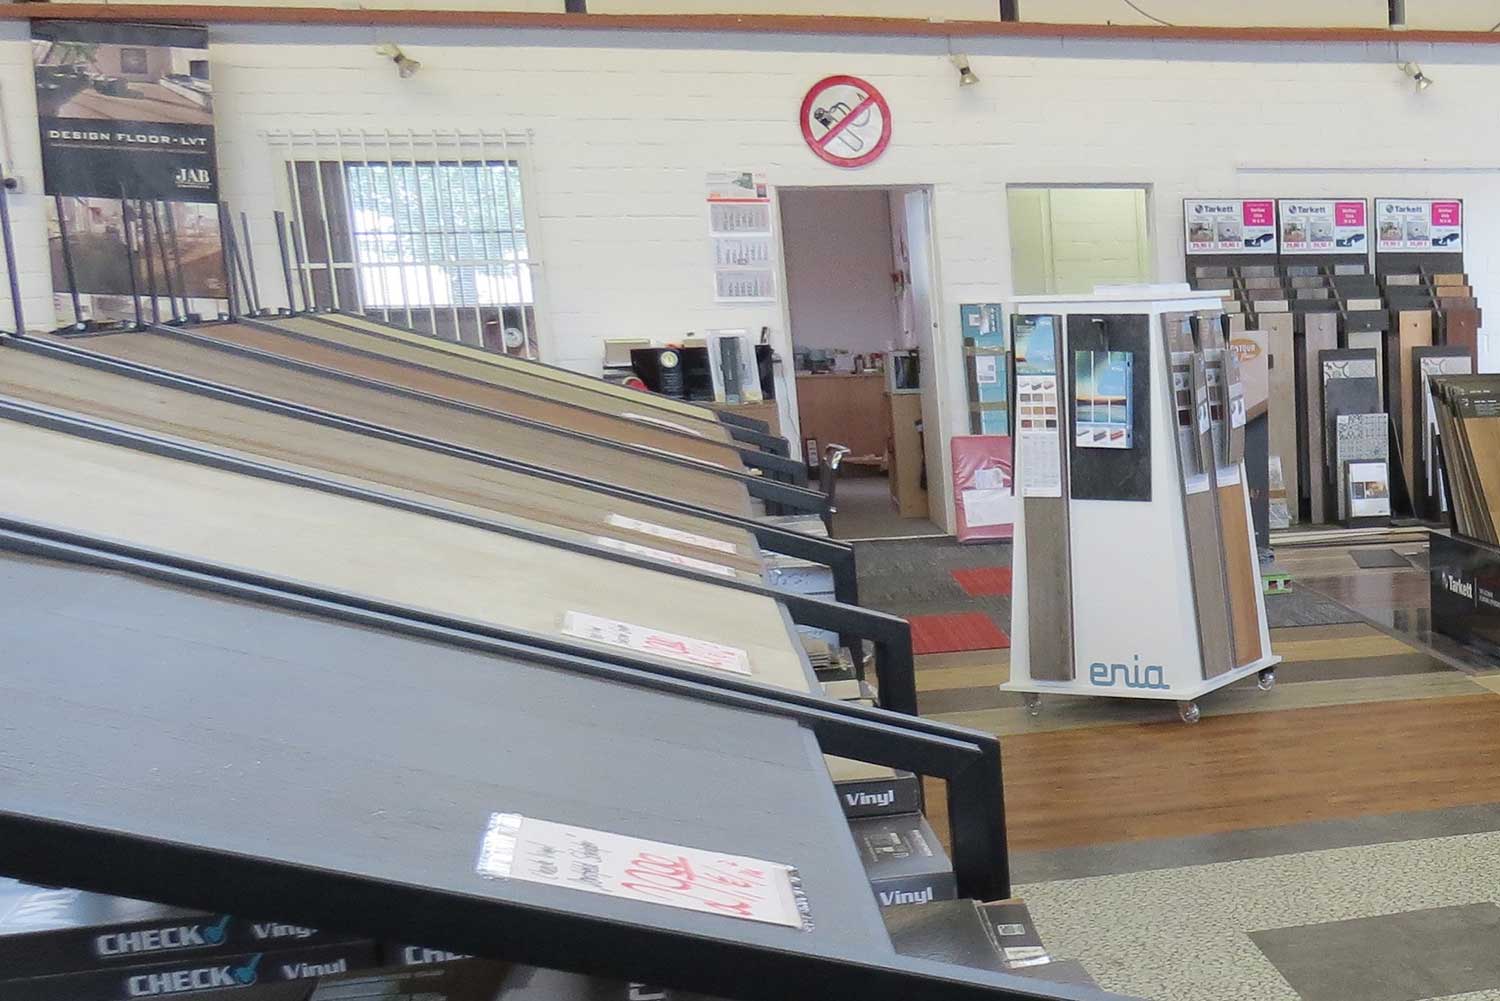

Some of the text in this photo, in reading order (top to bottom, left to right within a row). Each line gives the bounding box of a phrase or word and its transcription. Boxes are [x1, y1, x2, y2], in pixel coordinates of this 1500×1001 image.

[50, 130, 207, 145] DESIGN FLOOR LVT
[176, 168, 210, 183] JAB
[1205, 203, 1233, 213] Tarkett
[1298, 205, 1325, 214] Tarkett
[1395, 204, 1422, 213] Tarkett
[1448, 575, 1473, 599] Tarkett
[1089, 654, 1170, 689] enia
[846, 789, 894, 807] Vinyl
[879, 886, 933, 907] Vinyl
[97, 925, 204, 955] CHECK
[129, 965, 235, 996] CHECK
